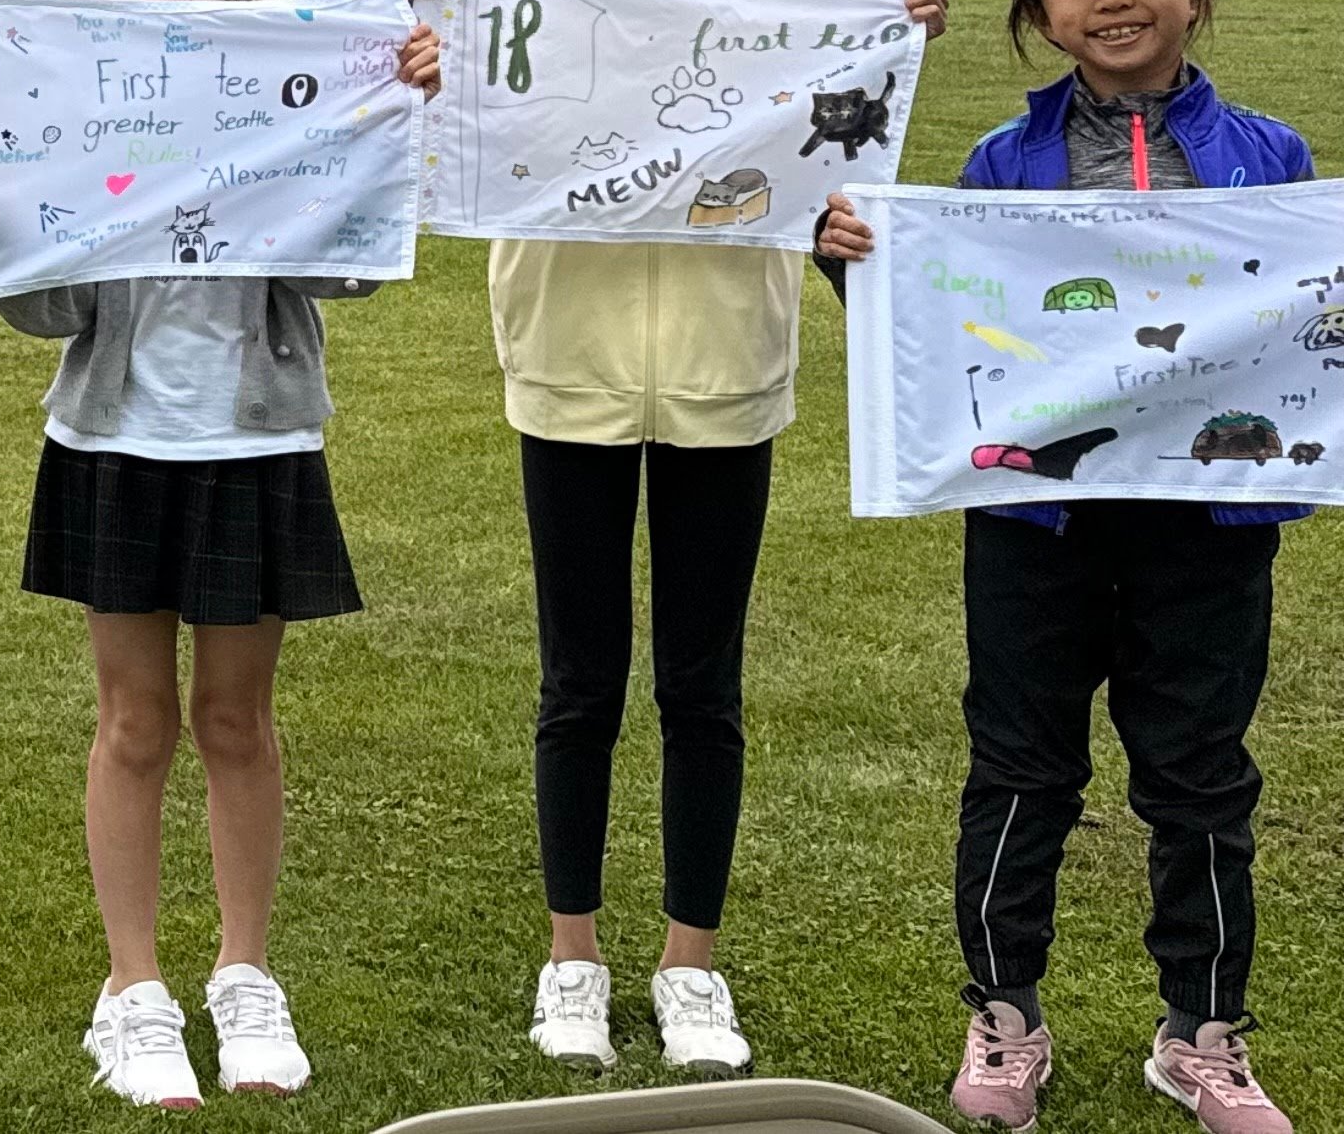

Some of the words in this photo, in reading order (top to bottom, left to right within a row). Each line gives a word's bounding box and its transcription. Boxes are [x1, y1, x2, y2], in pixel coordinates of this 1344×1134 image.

[95, 54, 172, 104] First
[215, 51, 262, 98] tee
[83, 116, 183, 153] greater
[566, 146, 683, 213] MEOW
[1114, 361, 1179, 392] First
